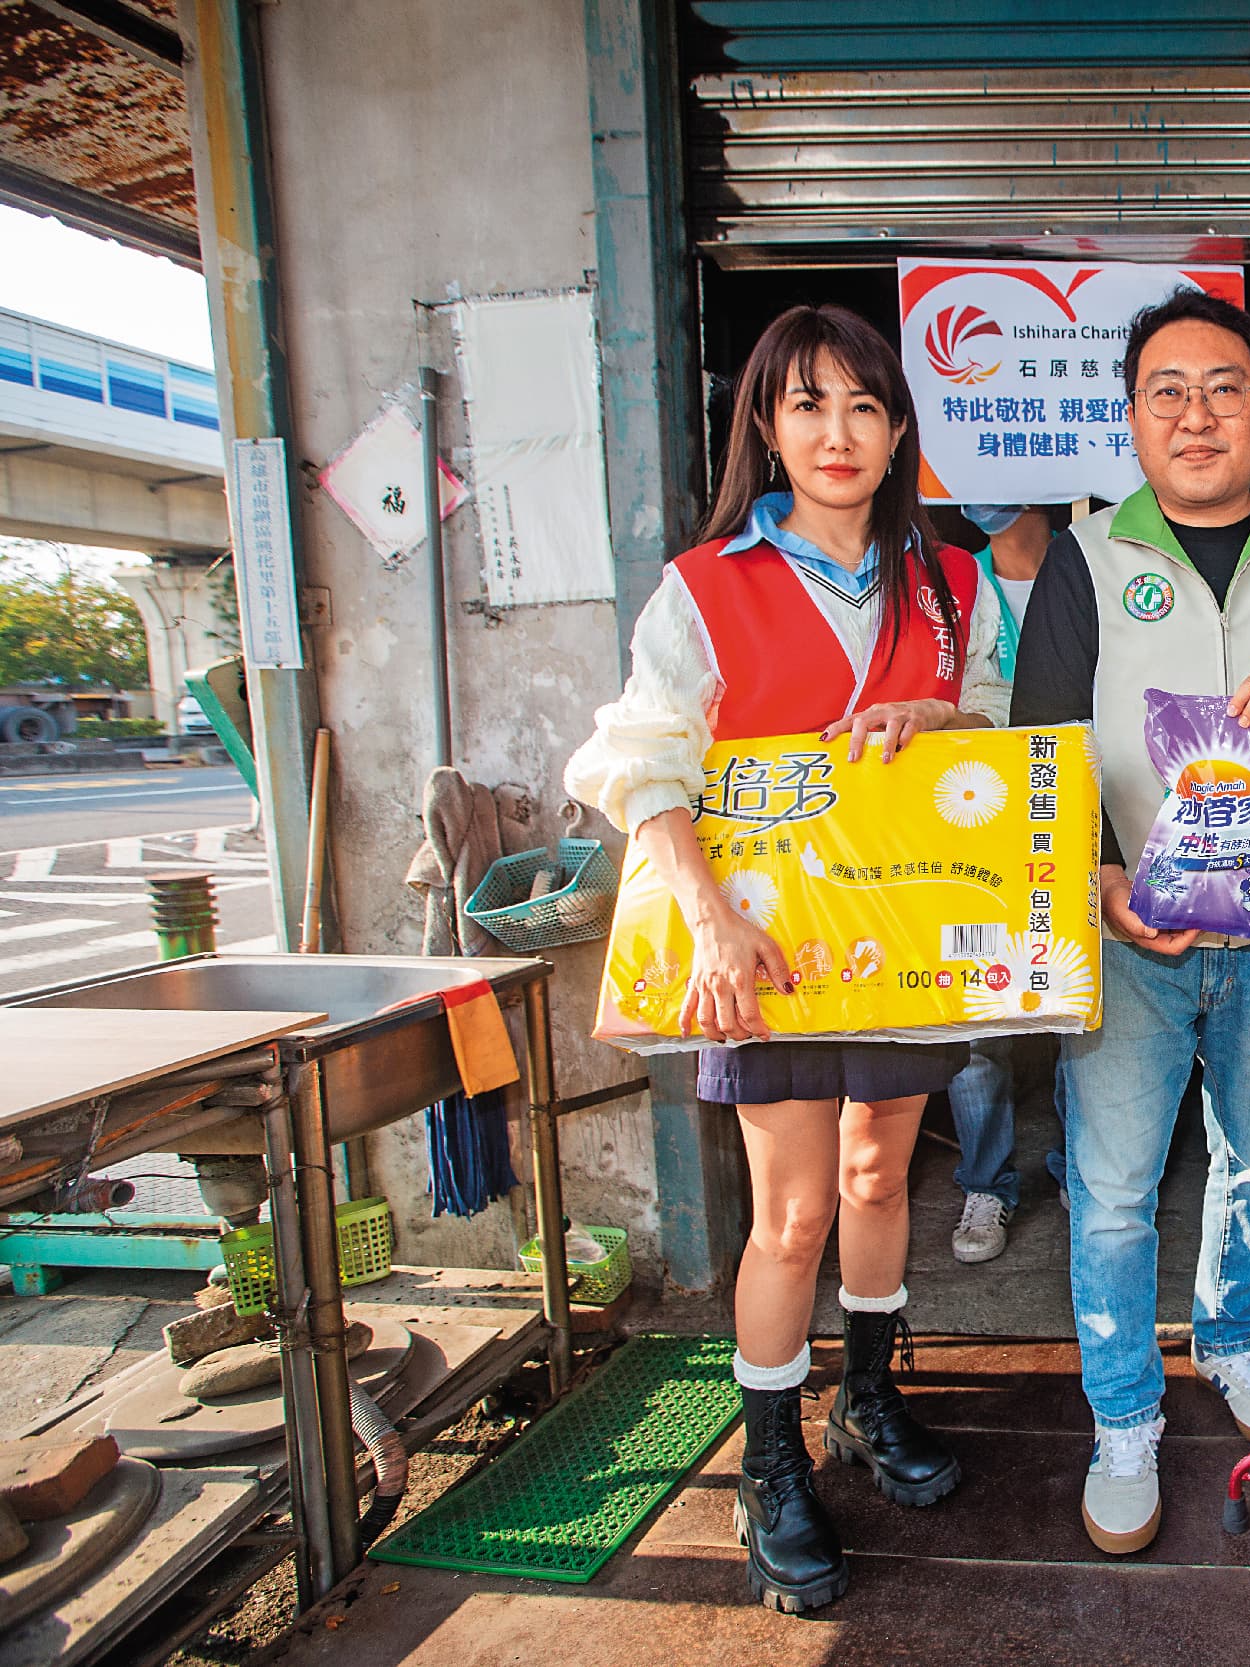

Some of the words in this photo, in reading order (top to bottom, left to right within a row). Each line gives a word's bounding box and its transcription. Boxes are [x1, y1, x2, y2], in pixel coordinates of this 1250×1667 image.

[1013, 325, 1076, 339] Ishihara
[1019, 359, 1126, 378] 石原慈善
[943, 397, 1046, 422] 特此敬祝
[1059, 397, 1129, 422] 親愛的
[382, 486, 405, 513] 福
[933, 626, 955, 681] 石原
[1029, 734, 1057, 820] 新發售
[1190, 782, 1215, 795] Magic
[1217, 780, 1246, 793] Amah
[700, 838, 792, 860] 式衛生紙
[1178, 832, 1220, 854] 中性
[898, 970, 932, 989] 100
[960, 969, 982, 987] 14
[986, 971, 1011, 986] 包入
